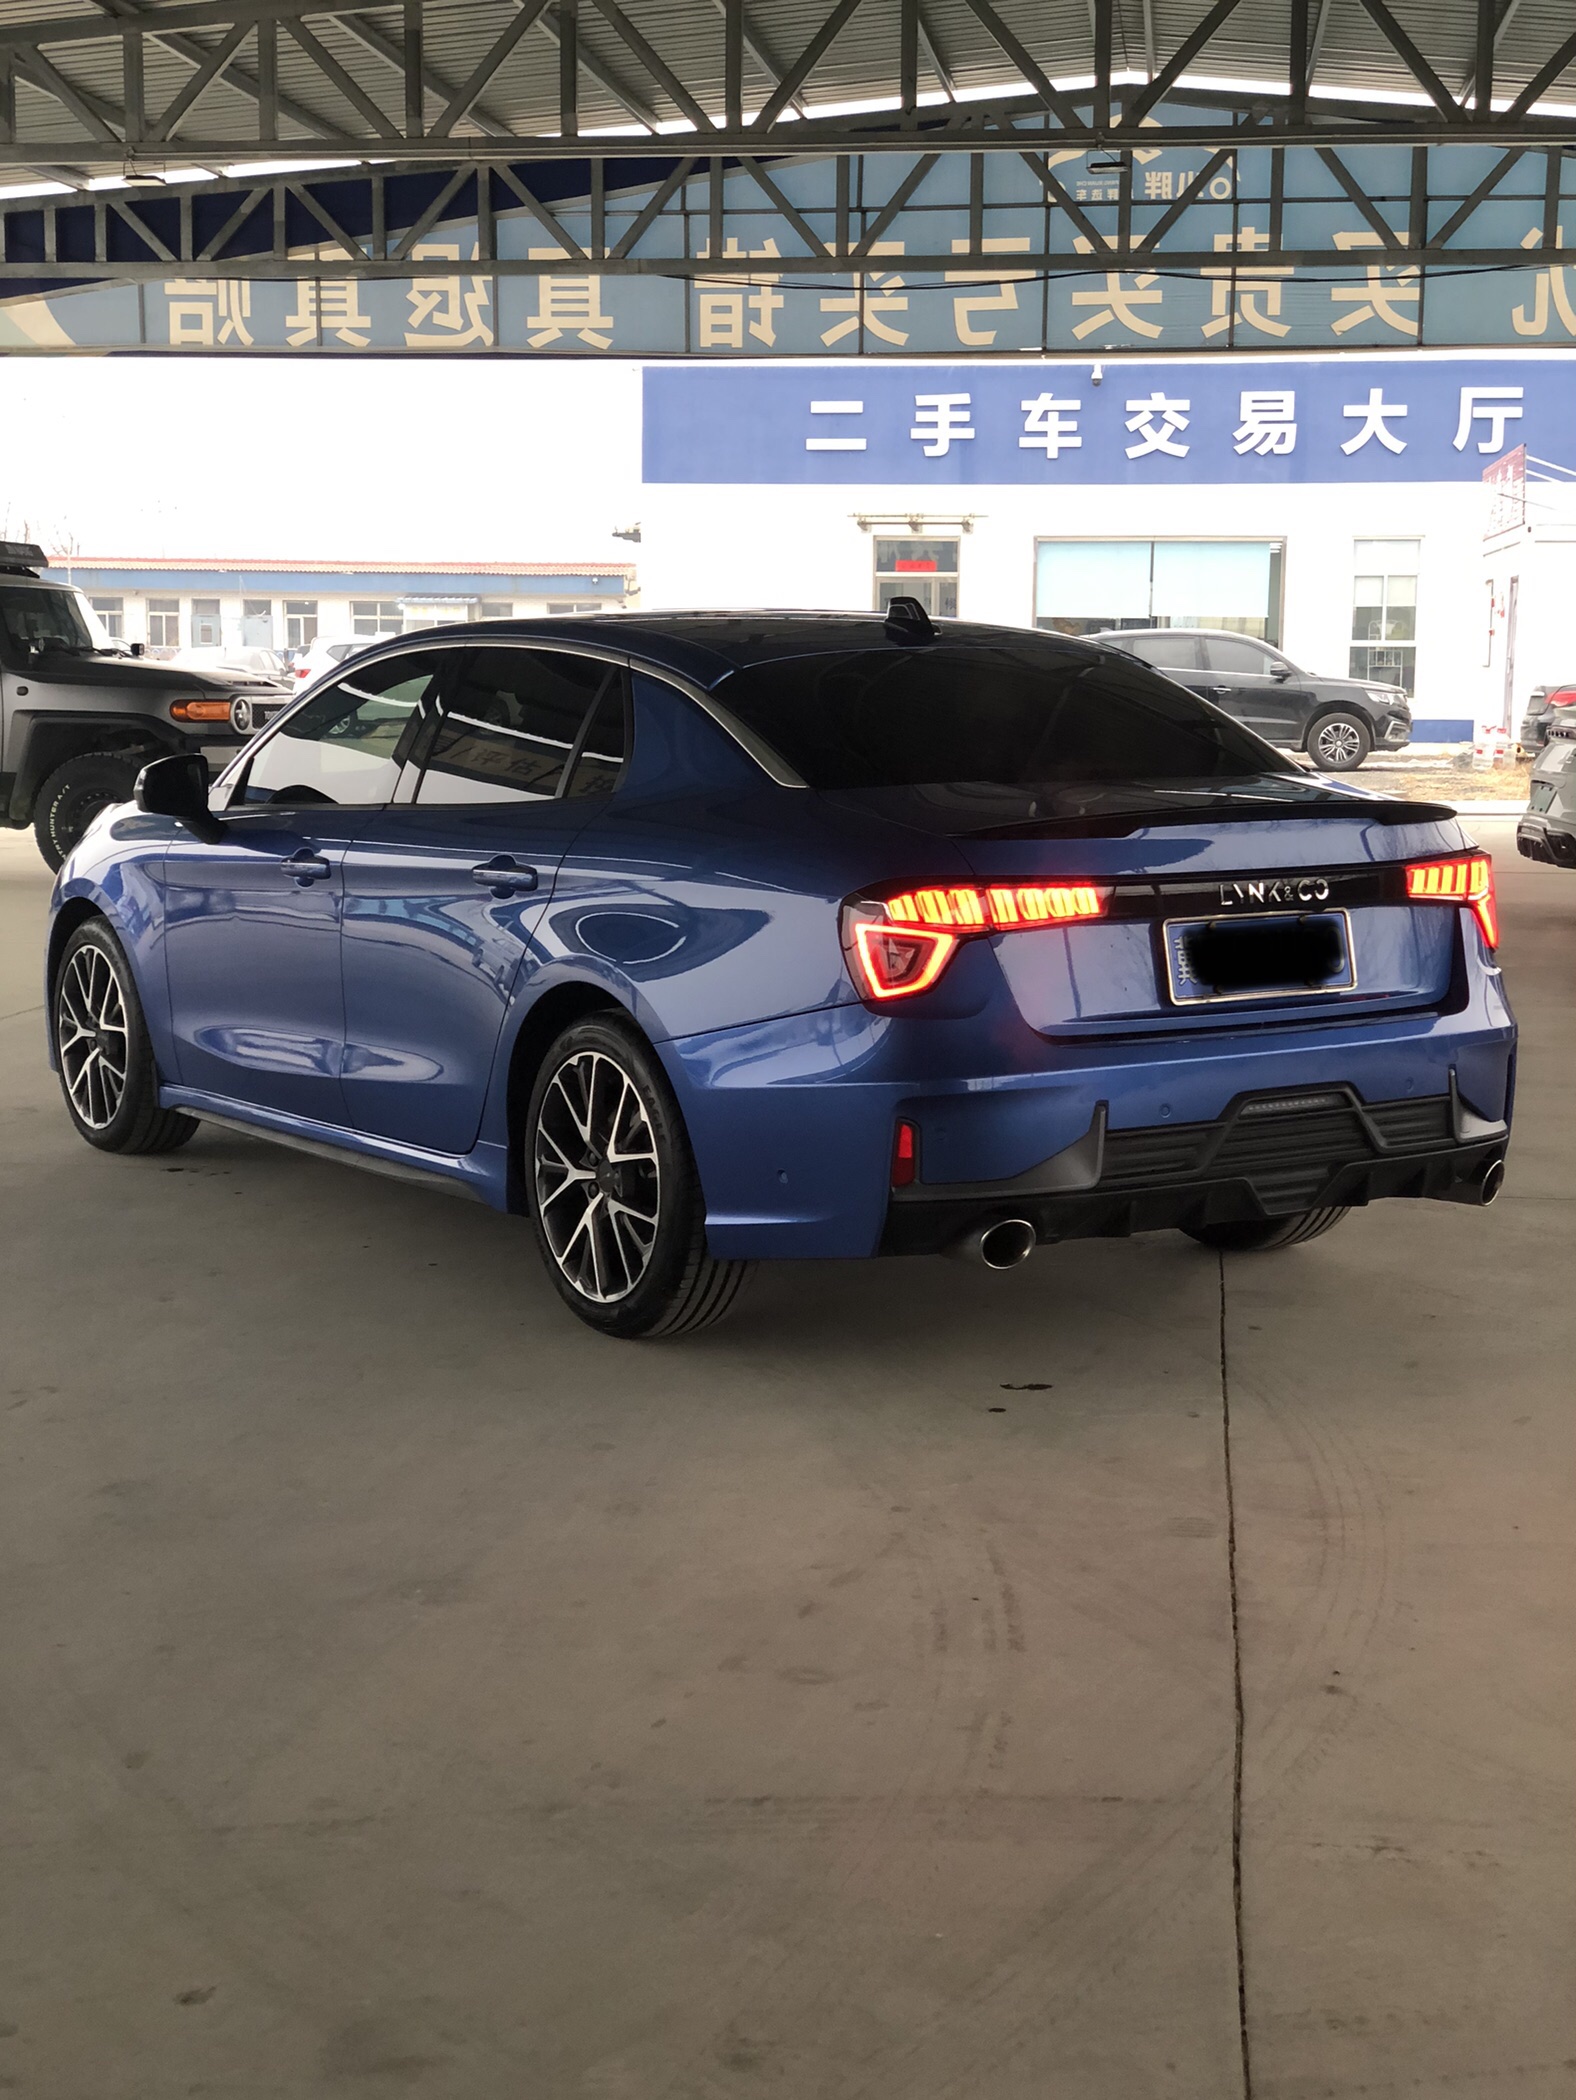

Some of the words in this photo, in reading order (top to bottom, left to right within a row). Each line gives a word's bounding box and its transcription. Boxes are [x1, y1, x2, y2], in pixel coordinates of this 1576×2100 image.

[805, 387, 1525, 460] 二手车交易大厅
